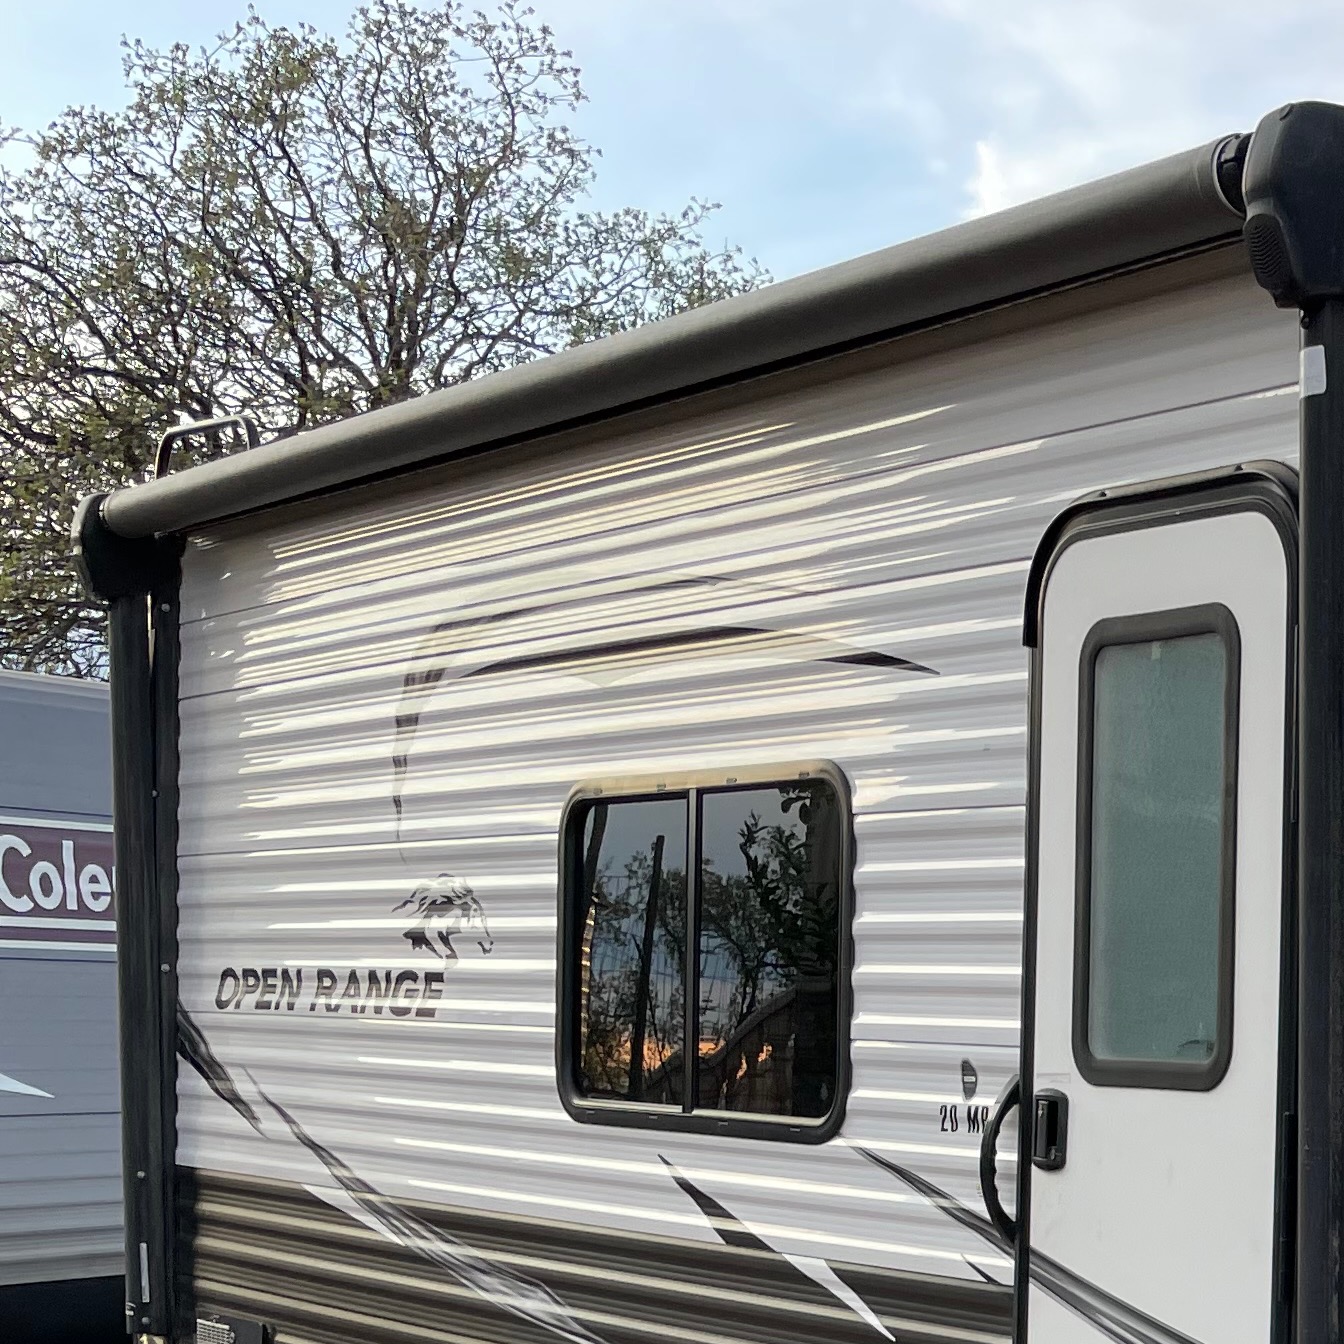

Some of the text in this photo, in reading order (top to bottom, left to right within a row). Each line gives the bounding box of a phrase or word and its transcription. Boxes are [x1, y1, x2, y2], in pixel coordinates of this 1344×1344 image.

[0, 834, 116, 913] Cole
[215, 966, 445, 1018] OPEN RANGE
[939, 1105, 959, 1132] 20
